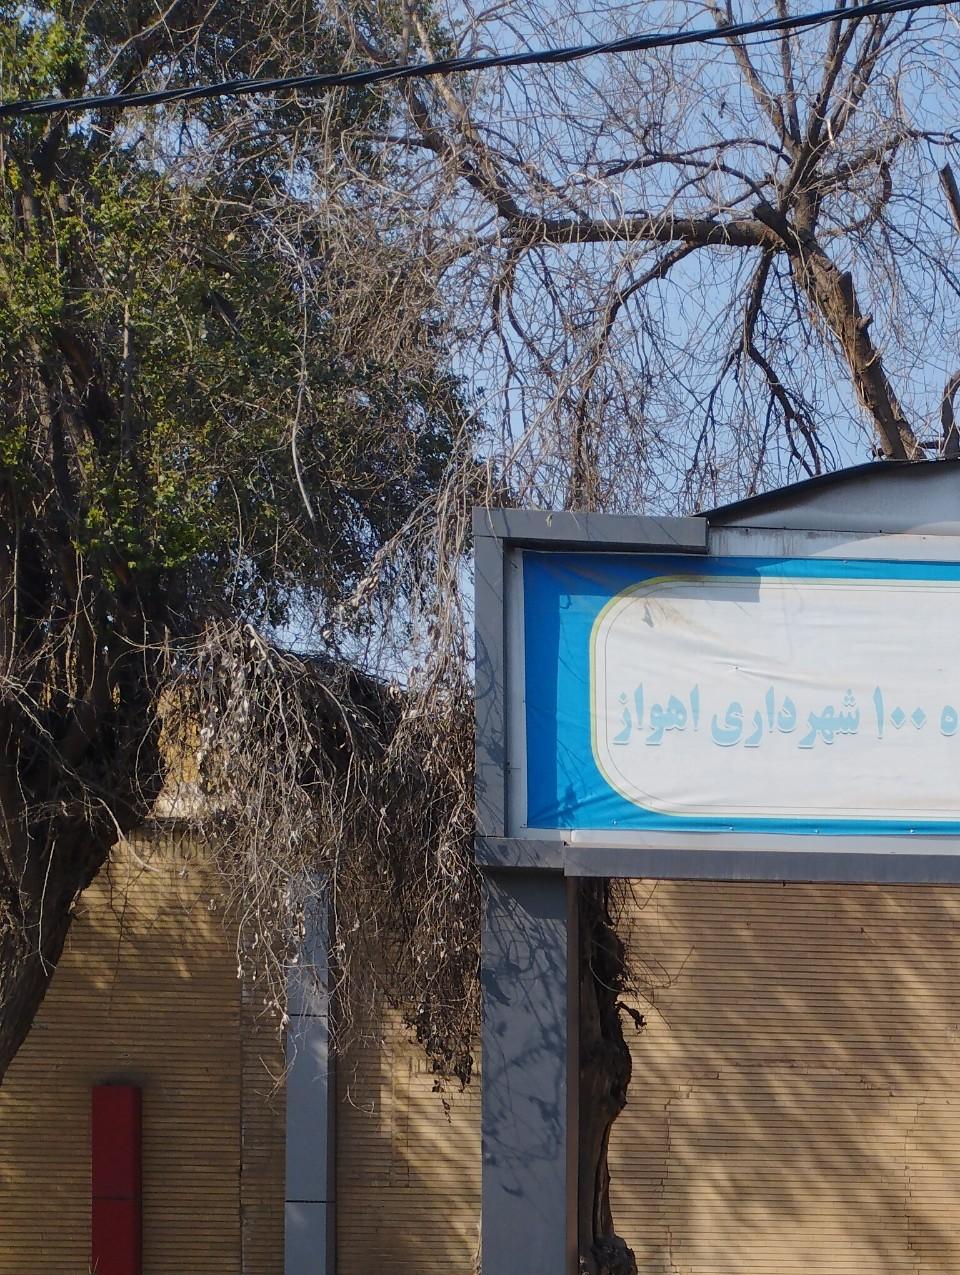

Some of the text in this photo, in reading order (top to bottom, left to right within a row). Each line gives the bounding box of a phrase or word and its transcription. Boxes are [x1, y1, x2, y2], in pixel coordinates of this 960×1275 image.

[612, 682, 701, 747] اهواز
[711, 685, 862, 750] شهرداری
[873, 685, 926, 739] ۱۰۰
